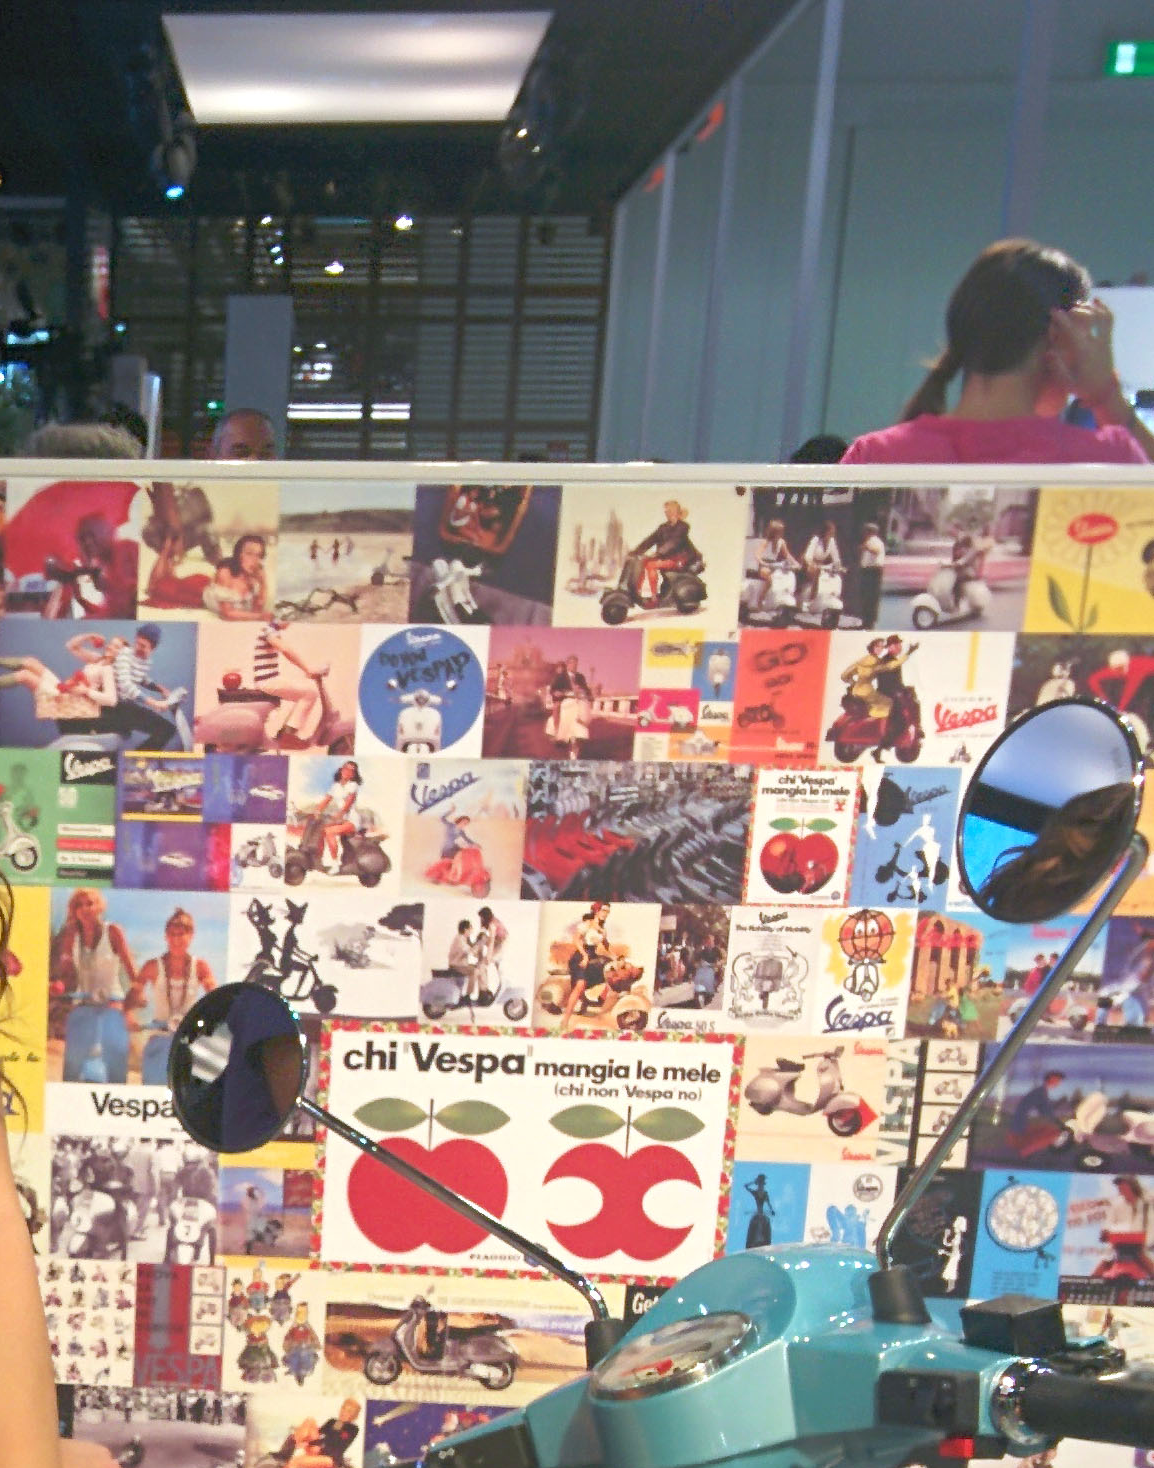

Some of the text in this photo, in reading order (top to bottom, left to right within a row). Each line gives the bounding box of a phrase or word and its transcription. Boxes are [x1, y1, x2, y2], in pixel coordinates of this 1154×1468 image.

[934, 702, 998, 733] Vespa
[64, 752, 116, 781] Vespa
[411, 783, 481, 813] Vespa
[657, 1010, 694, 1030] Vespa
[823, 995, 895, 1034] Vespa
[344, 1040, 397, 1071] chi
[534, 1059, 631, 1084] mangia
[637, 1060, 658, 1080] le
[663, 1062, 722, 1083] mele
[587, 1085, 619, 1098] non
[678, 1087, 703, 1102] no)
